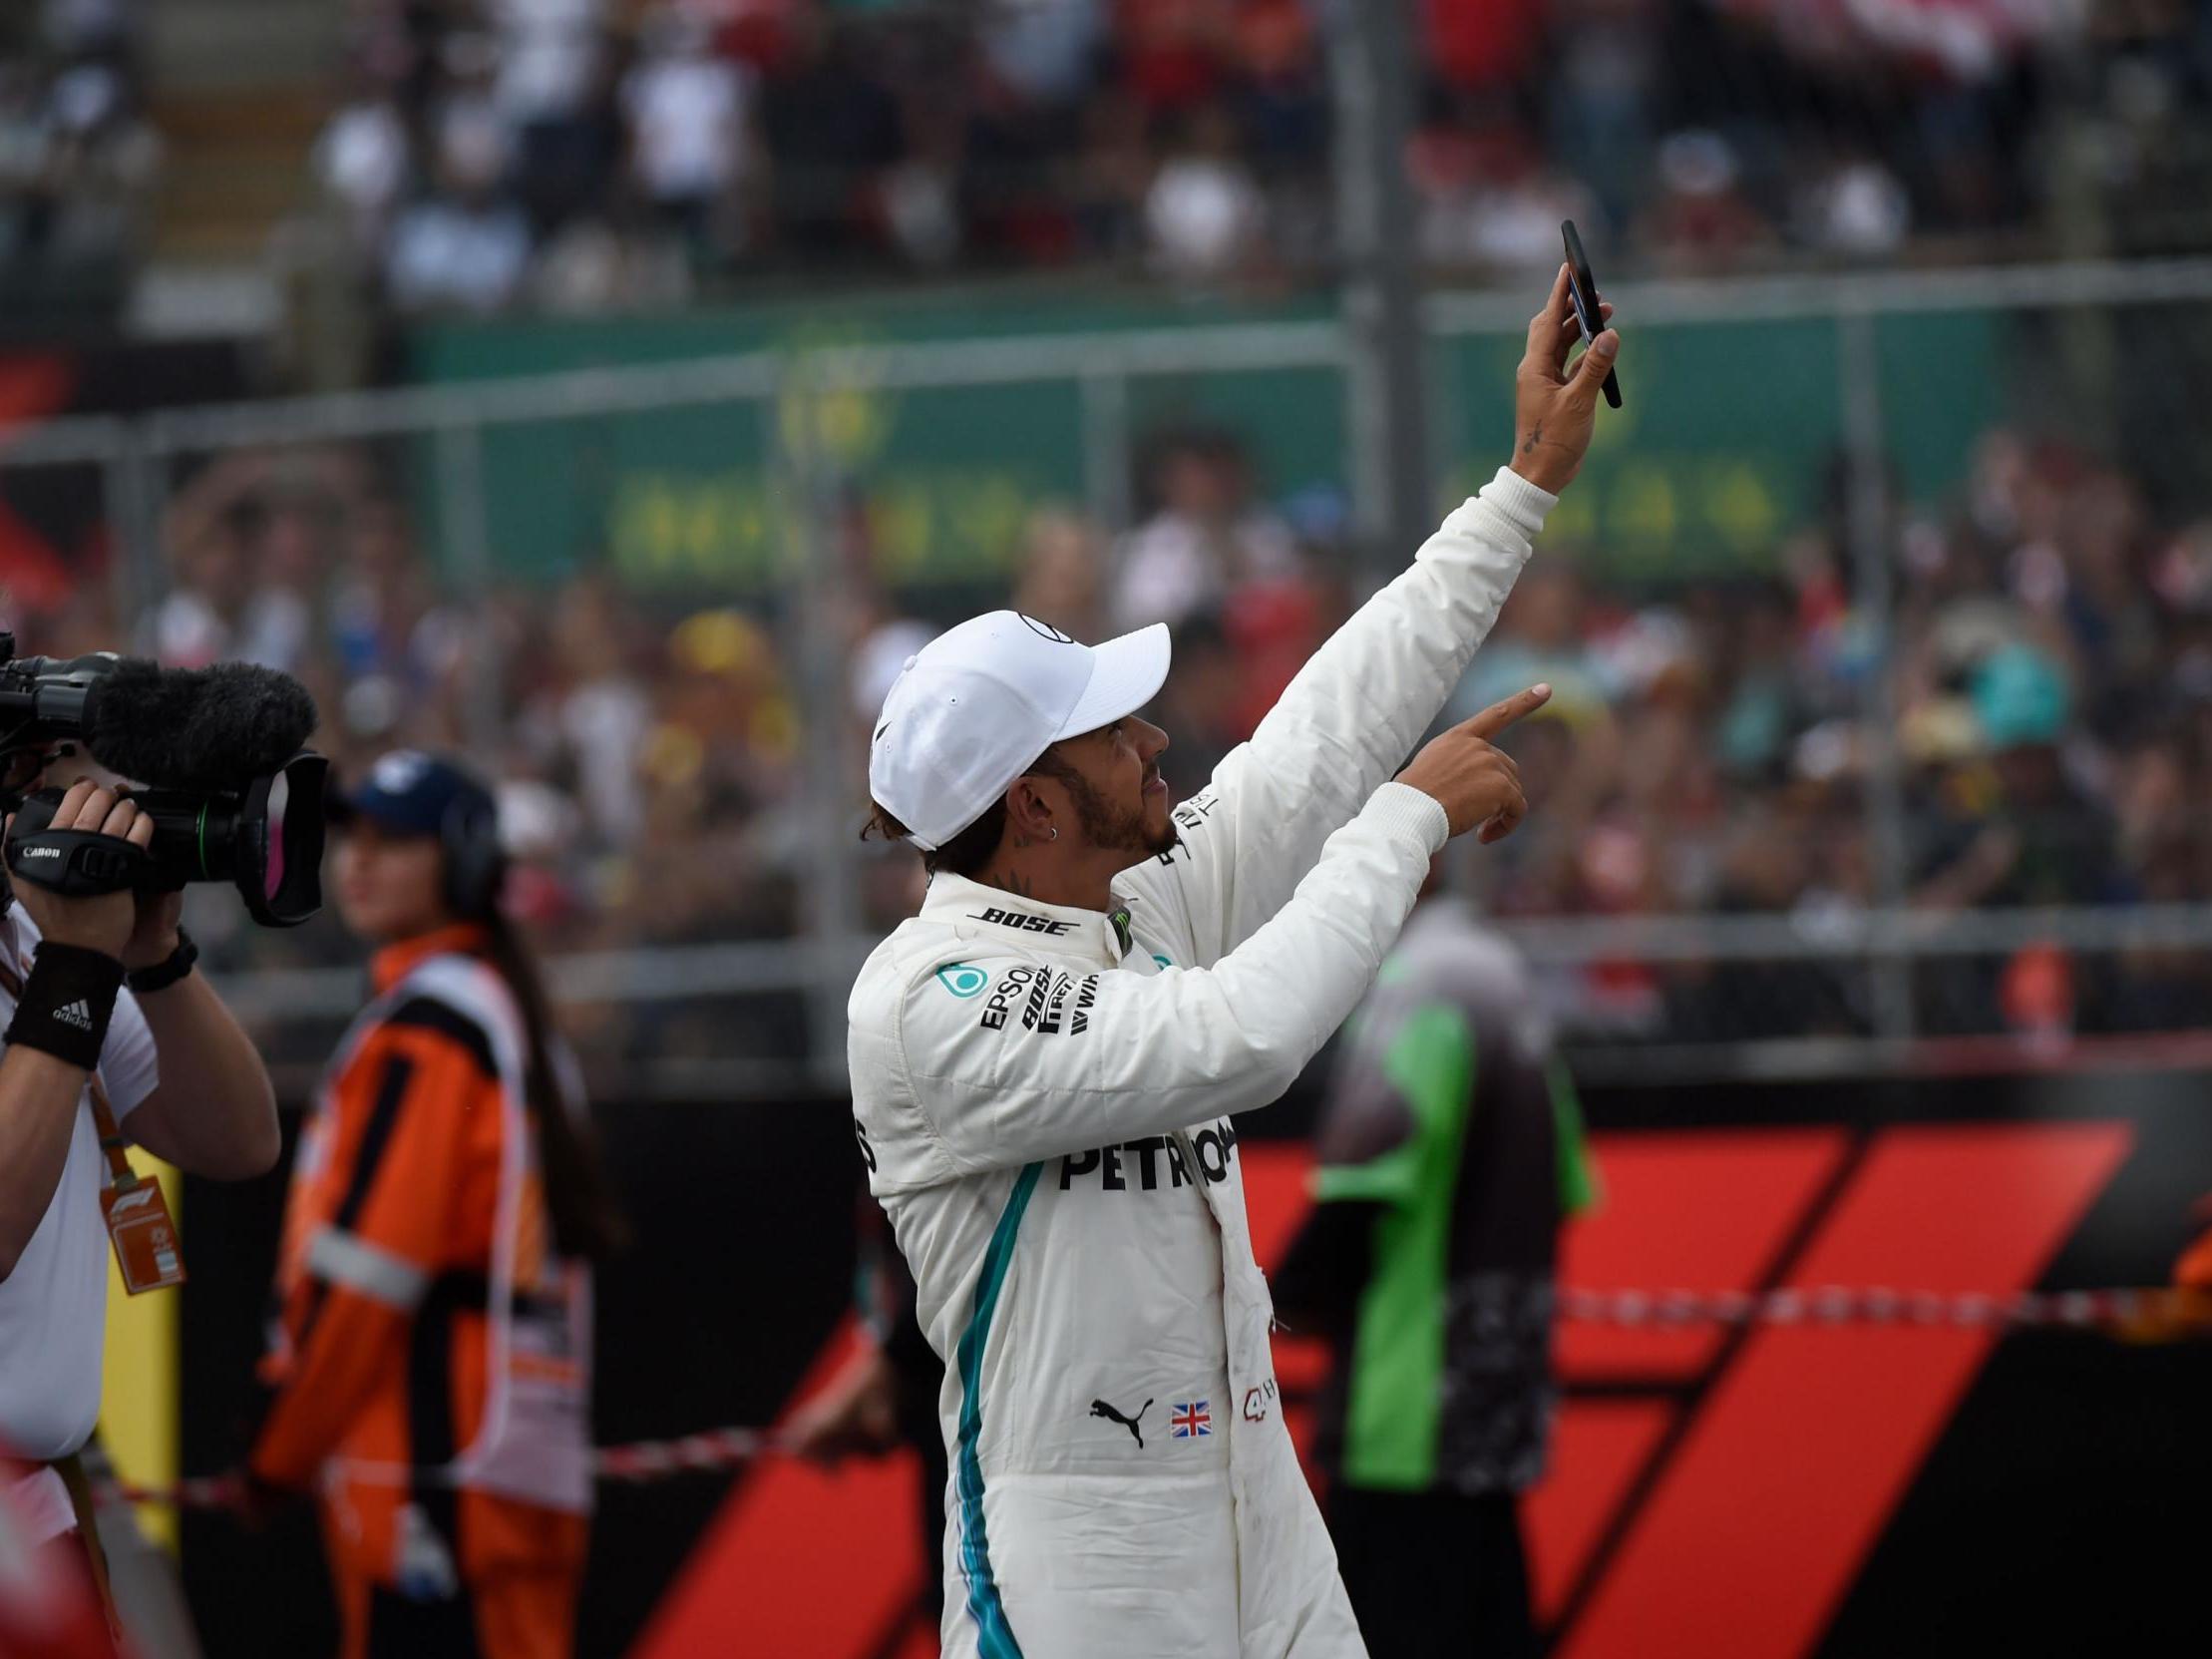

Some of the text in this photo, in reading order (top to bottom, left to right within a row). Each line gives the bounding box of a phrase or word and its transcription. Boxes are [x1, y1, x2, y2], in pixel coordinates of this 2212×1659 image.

[23, 846, 61, 859] Canon
[965, 907, 1081, 936] BOSE
[980, 967, 1035, 1031] EPSO
[53, 1009, 93, 1031] adidas
